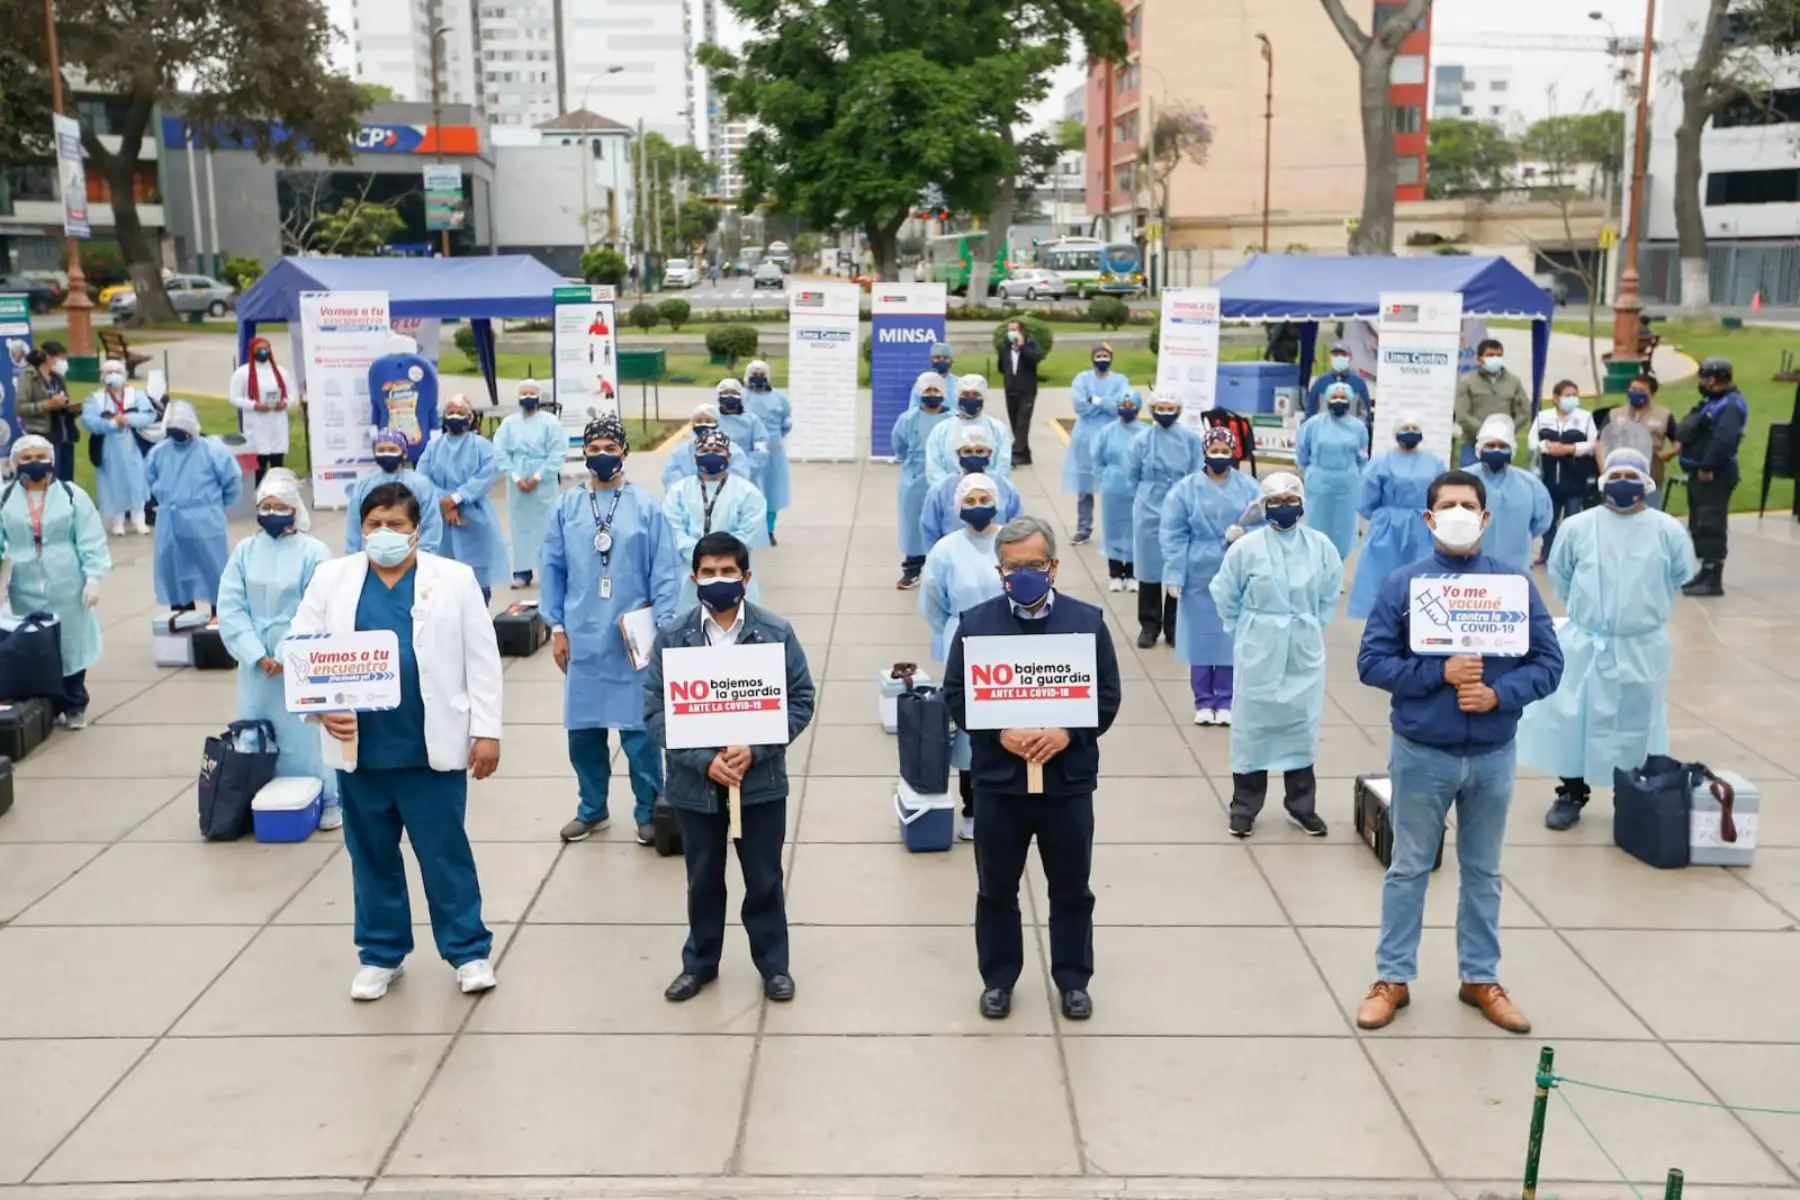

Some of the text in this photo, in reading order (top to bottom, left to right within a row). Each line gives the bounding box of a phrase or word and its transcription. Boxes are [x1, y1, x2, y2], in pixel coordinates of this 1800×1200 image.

[346, 127, 386, 148] CP
[320, 306, 359, 317] Vamos
[879, 328, 937, 343] MINSA
[1442, 585, 1487, 598] Yo me
[1448, 597, 1501, 609] vacuné
[1456, 611, 1501, 621] contra la
[1460, 623, 1515, 633] COVID-19
[309, 649, 389, 664] Vamos a tu
[313, 661, 388, 675] encuentro
[971, 662, 1071, 686] NO bajemos
[1020, 671, 1091, 687] la guardia
[669, 678, 764, 701] NO bajemos
[715, 685, 781, 700] la guardia
[990, 688, 1070, 698] ANTE LA COVID-19
[688, 701, 762, 713] ANTE LA COVID-19
